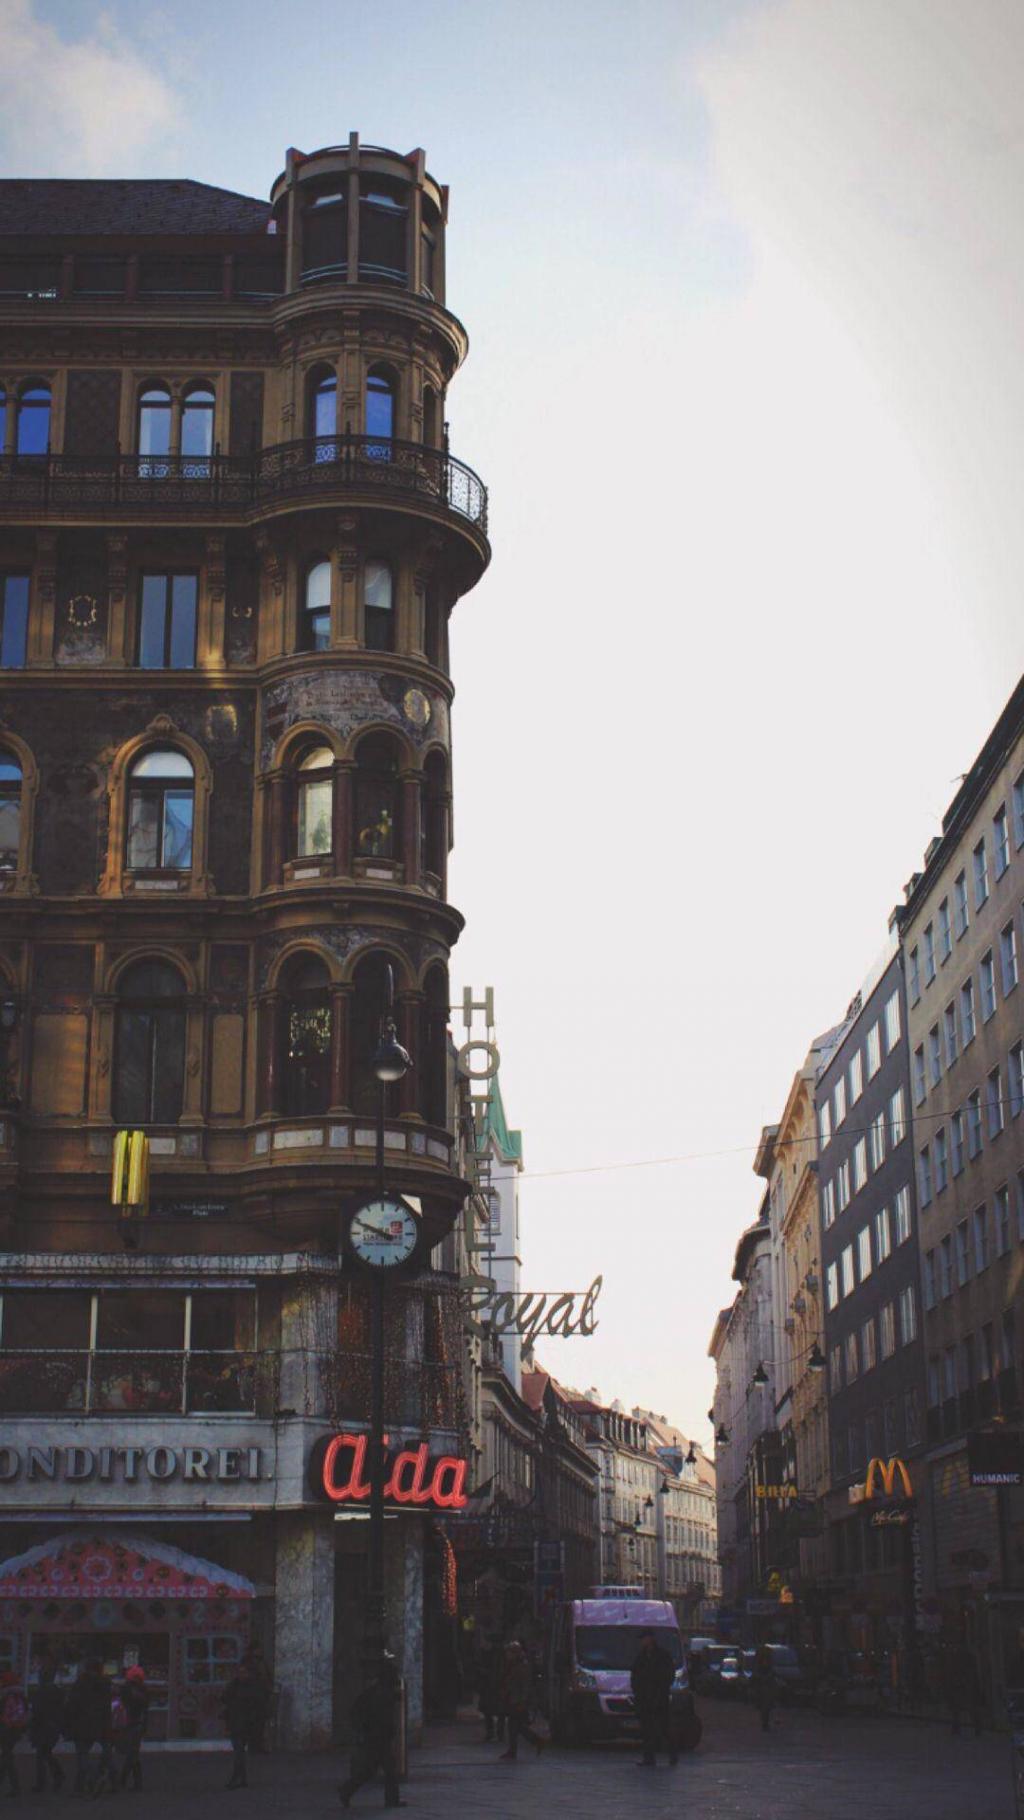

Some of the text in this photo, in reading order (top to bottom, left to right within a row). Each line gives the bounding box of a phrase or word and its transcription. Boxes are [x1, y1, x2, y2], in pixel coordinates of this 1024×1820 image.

[457, 986, 500, 1252] HOTEL
[459, 1275, 603, 1360] Royal
[755, 1484, 799, 1499] BILLA
[972, 1472, 1021, 1484] HUMANIC
